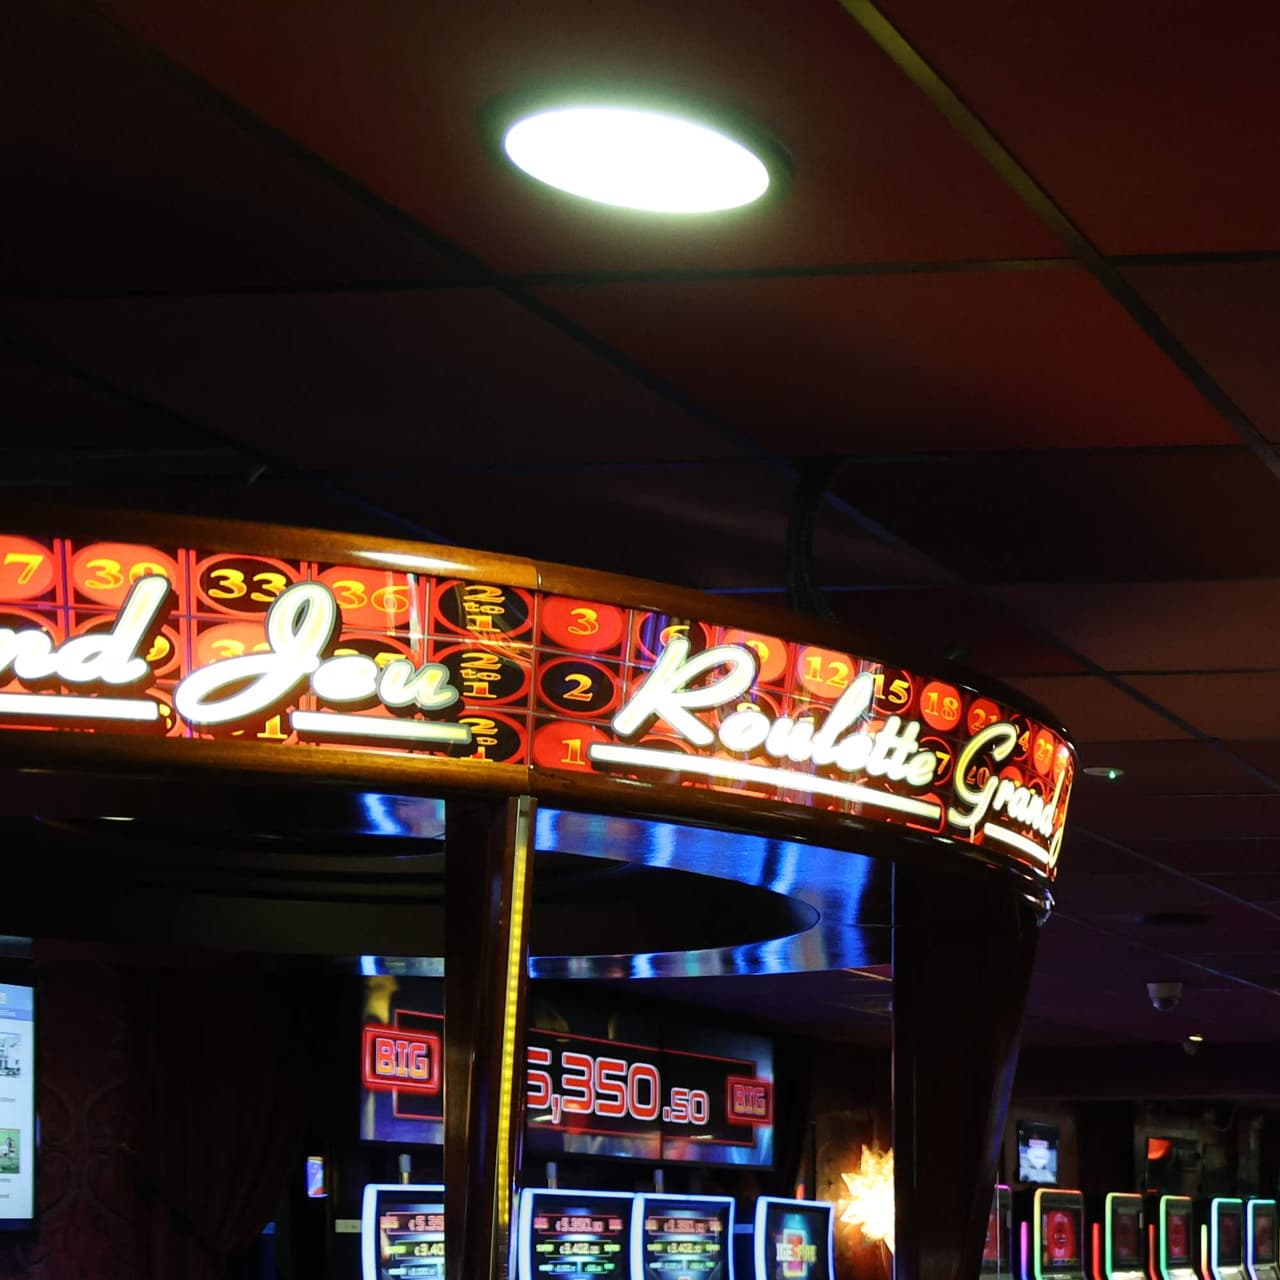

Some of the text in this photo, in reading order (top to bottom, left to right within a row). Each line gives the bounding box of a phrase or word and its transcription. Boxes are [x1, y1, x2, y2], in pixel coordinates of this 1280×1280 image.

[332, 580, 409, 613] 36
[567, 608, 599, 635] 3
[804, 656, 848, 687] 12
[872, 674, 909, 704] 15
[925, 692, 958, 721] 18
[563, 673, 593, 702] 2
[561, 738, 586, 765] 1
[611, 636, 938, 786] Roulette
[948, 722, 1068, 838] Grand
[375, 1037, 430, 1081] BIG
[733, 1084, 767, 1117] BIG
